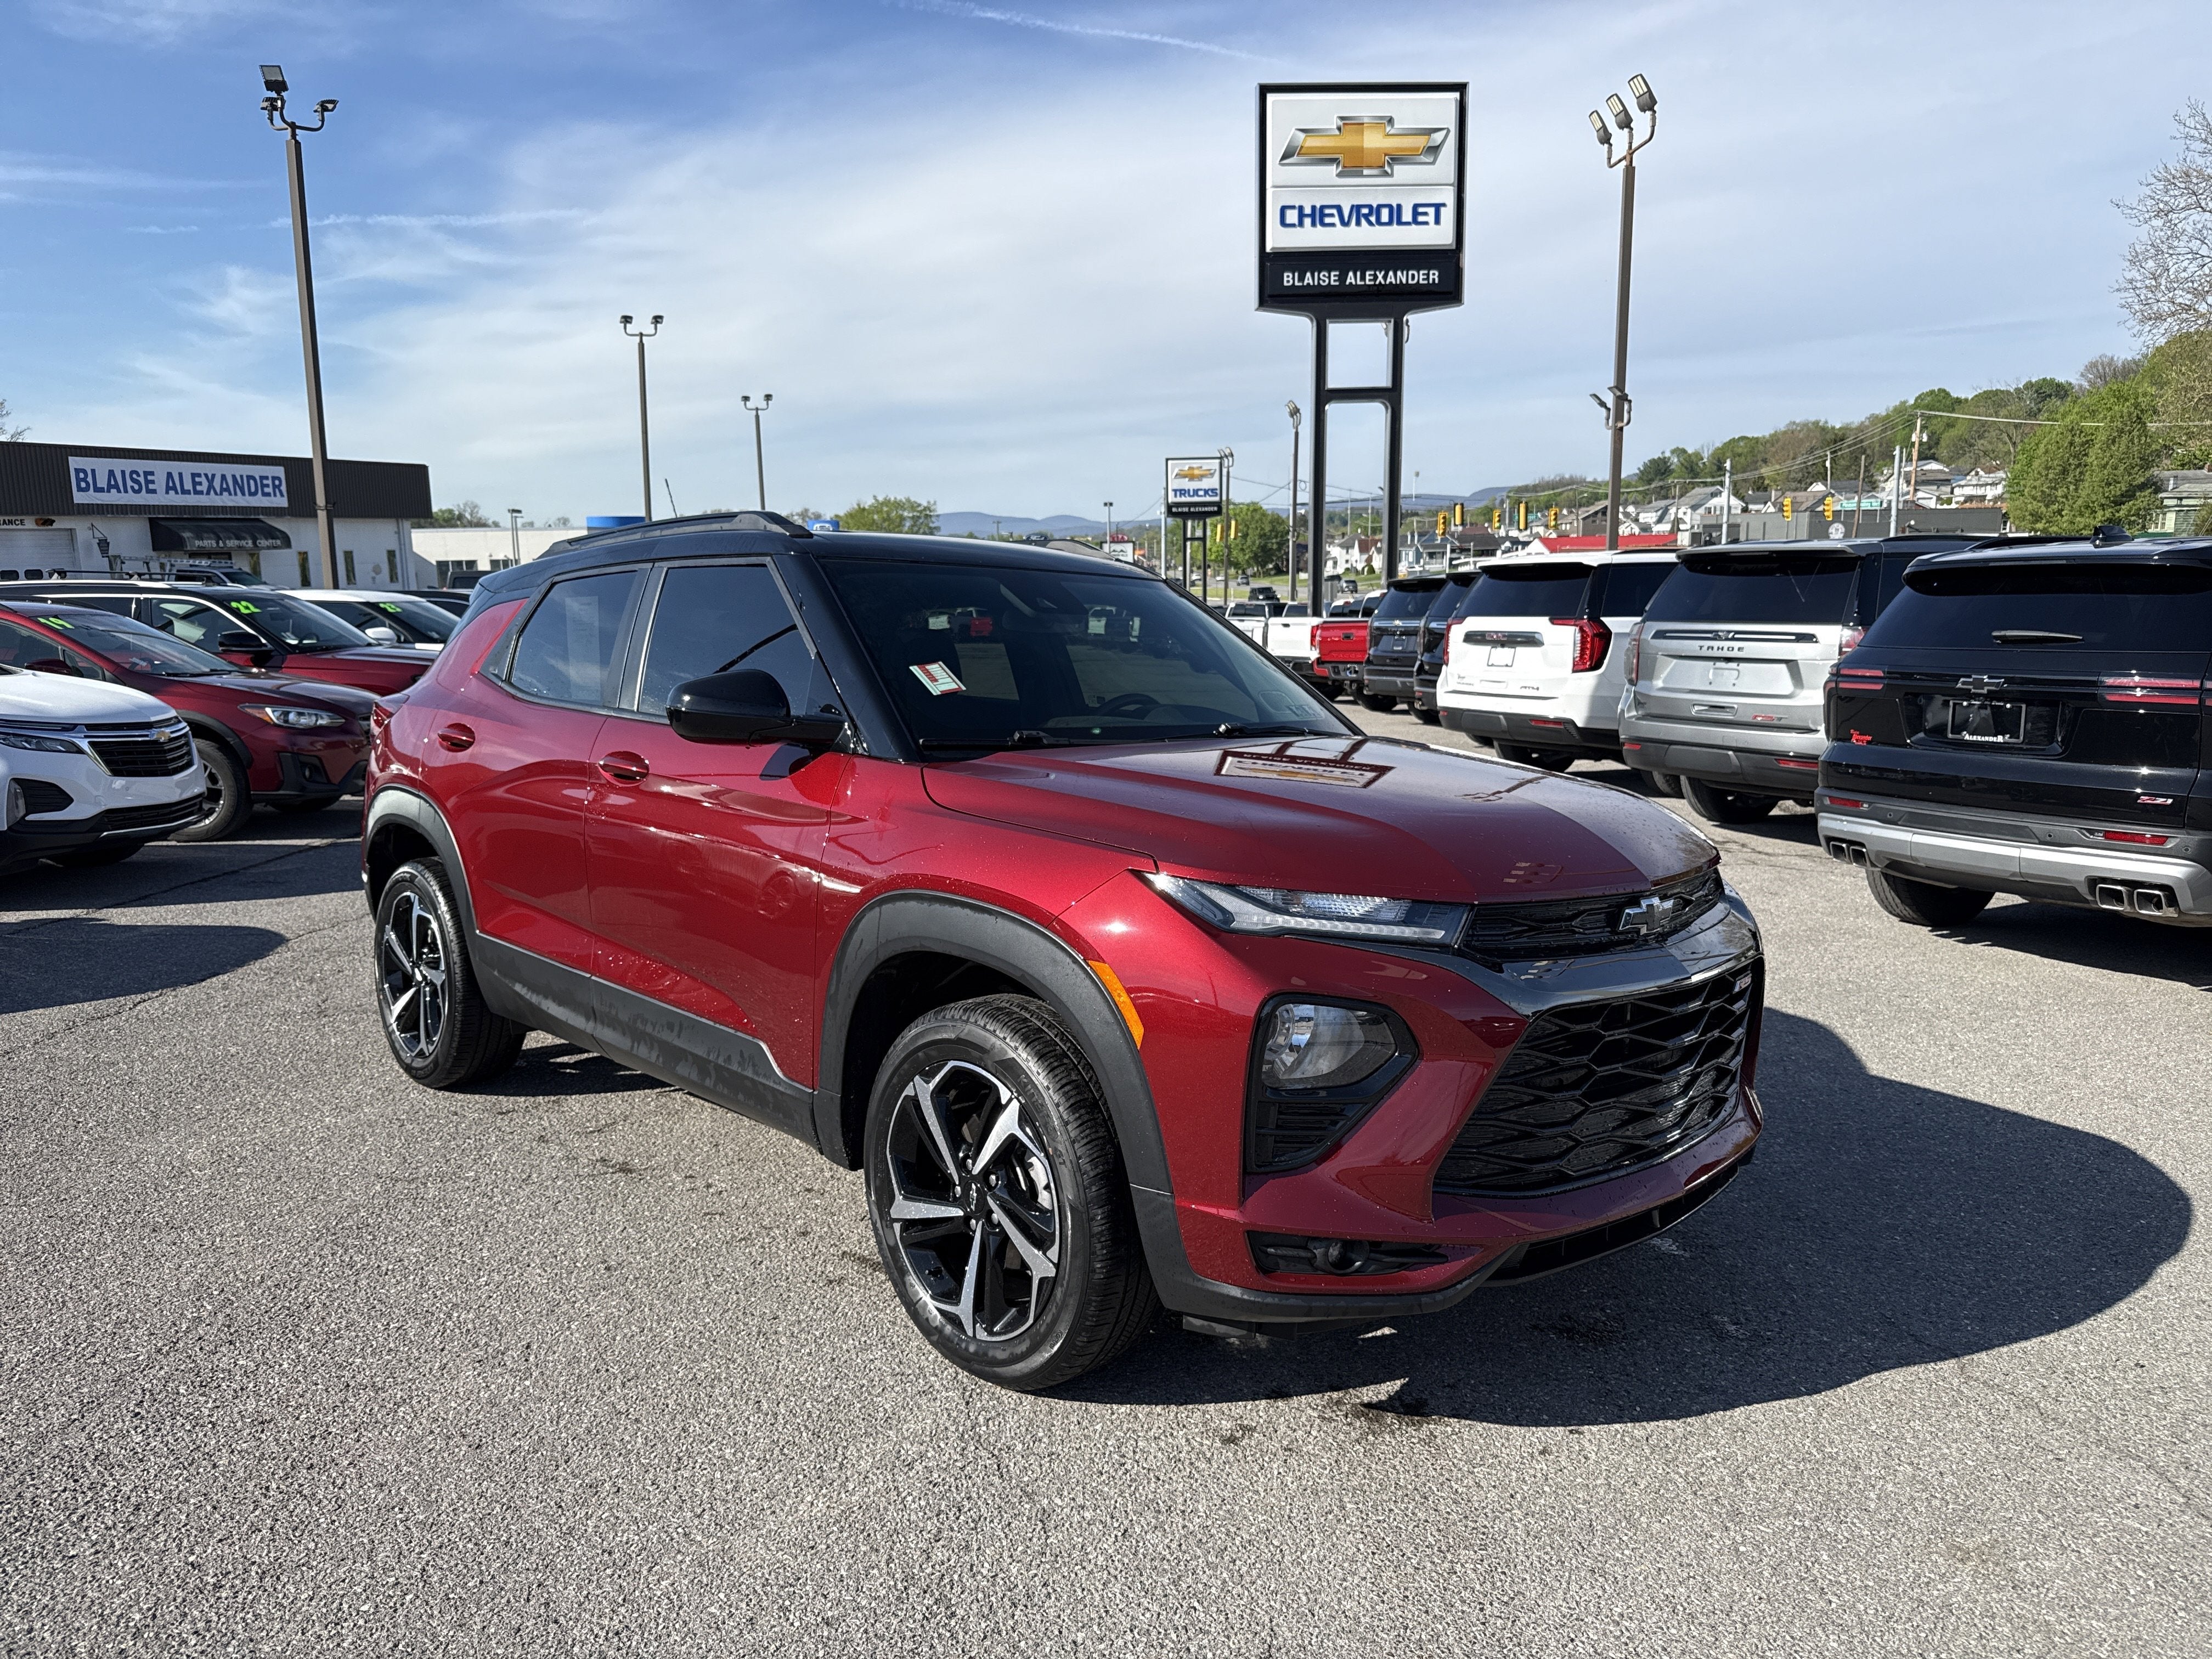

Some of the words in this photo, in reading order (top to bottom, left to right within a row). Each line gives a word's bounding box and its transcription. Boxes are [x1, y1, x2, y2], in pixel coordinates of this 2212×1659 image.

[1279, 203, 1447, 228] CHEVROLET
[1283, 272, 1340, 286] BLAISE
[1345, 270, 1440, 285] ALEXANDER
[74, 467, 157, 494] BLAISE
[165, 471, 285, 498] ALEXANDER
[1172, 488, 1218, 498] TRUCKS
[195, 539, 217, 548] PARTS
[230, 600, 263, 614] 22
[37, 617, 75, 630] 19
[1963, 733, 2003, 742] ALEXANDER
